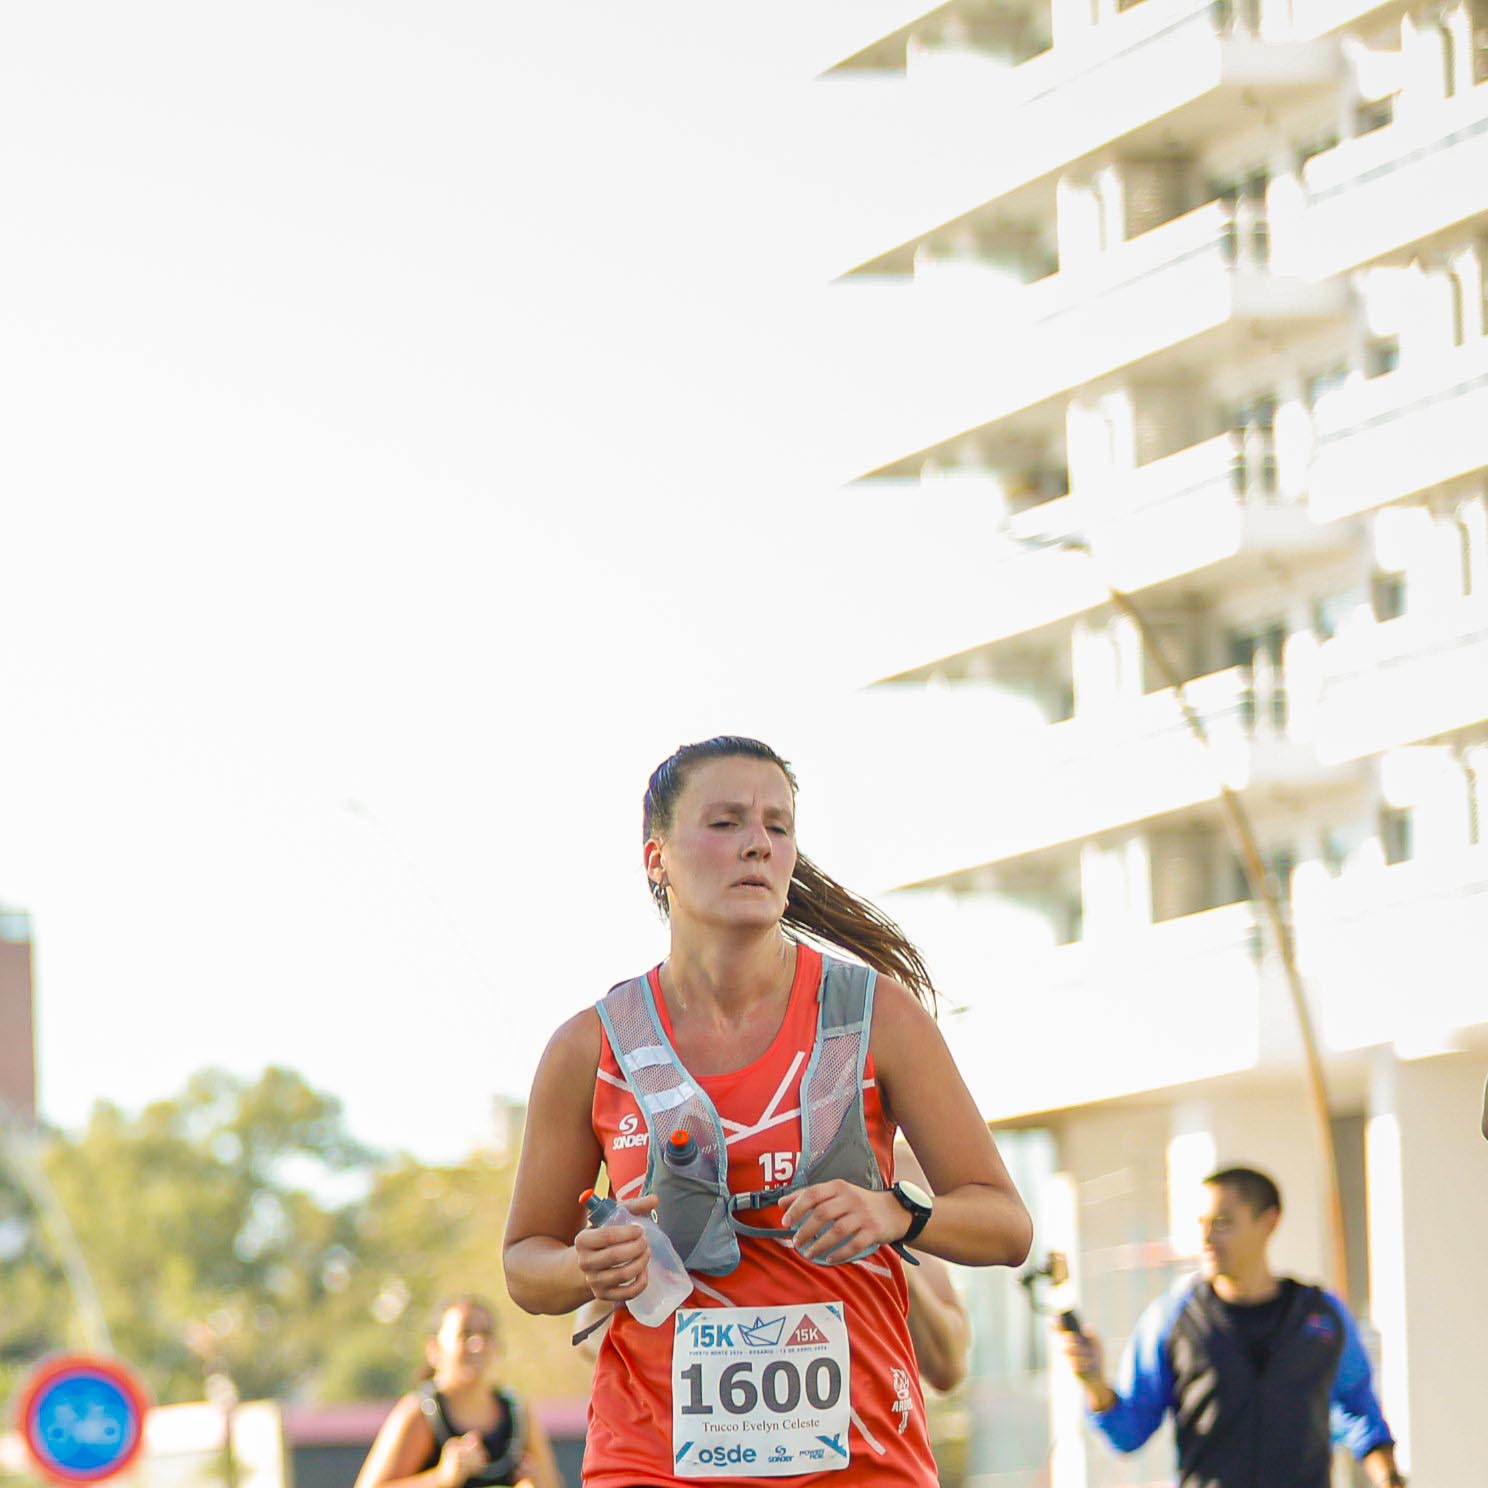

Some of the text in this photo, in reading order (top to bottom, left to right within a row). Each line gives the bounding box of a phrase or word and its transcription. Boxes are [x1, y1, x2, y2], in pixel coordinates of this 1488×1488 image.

[758, 1151, 800, 1182] 15
[690, 1324, 734, 1347] 15K
[795, 1327, 820, 1342] 15K
[680, 1357, 842, 1415] 1600
[702, 1419, 820, 1434] Trucco Evelyn Celeste
[698, 1443, 757, 1465] osde
